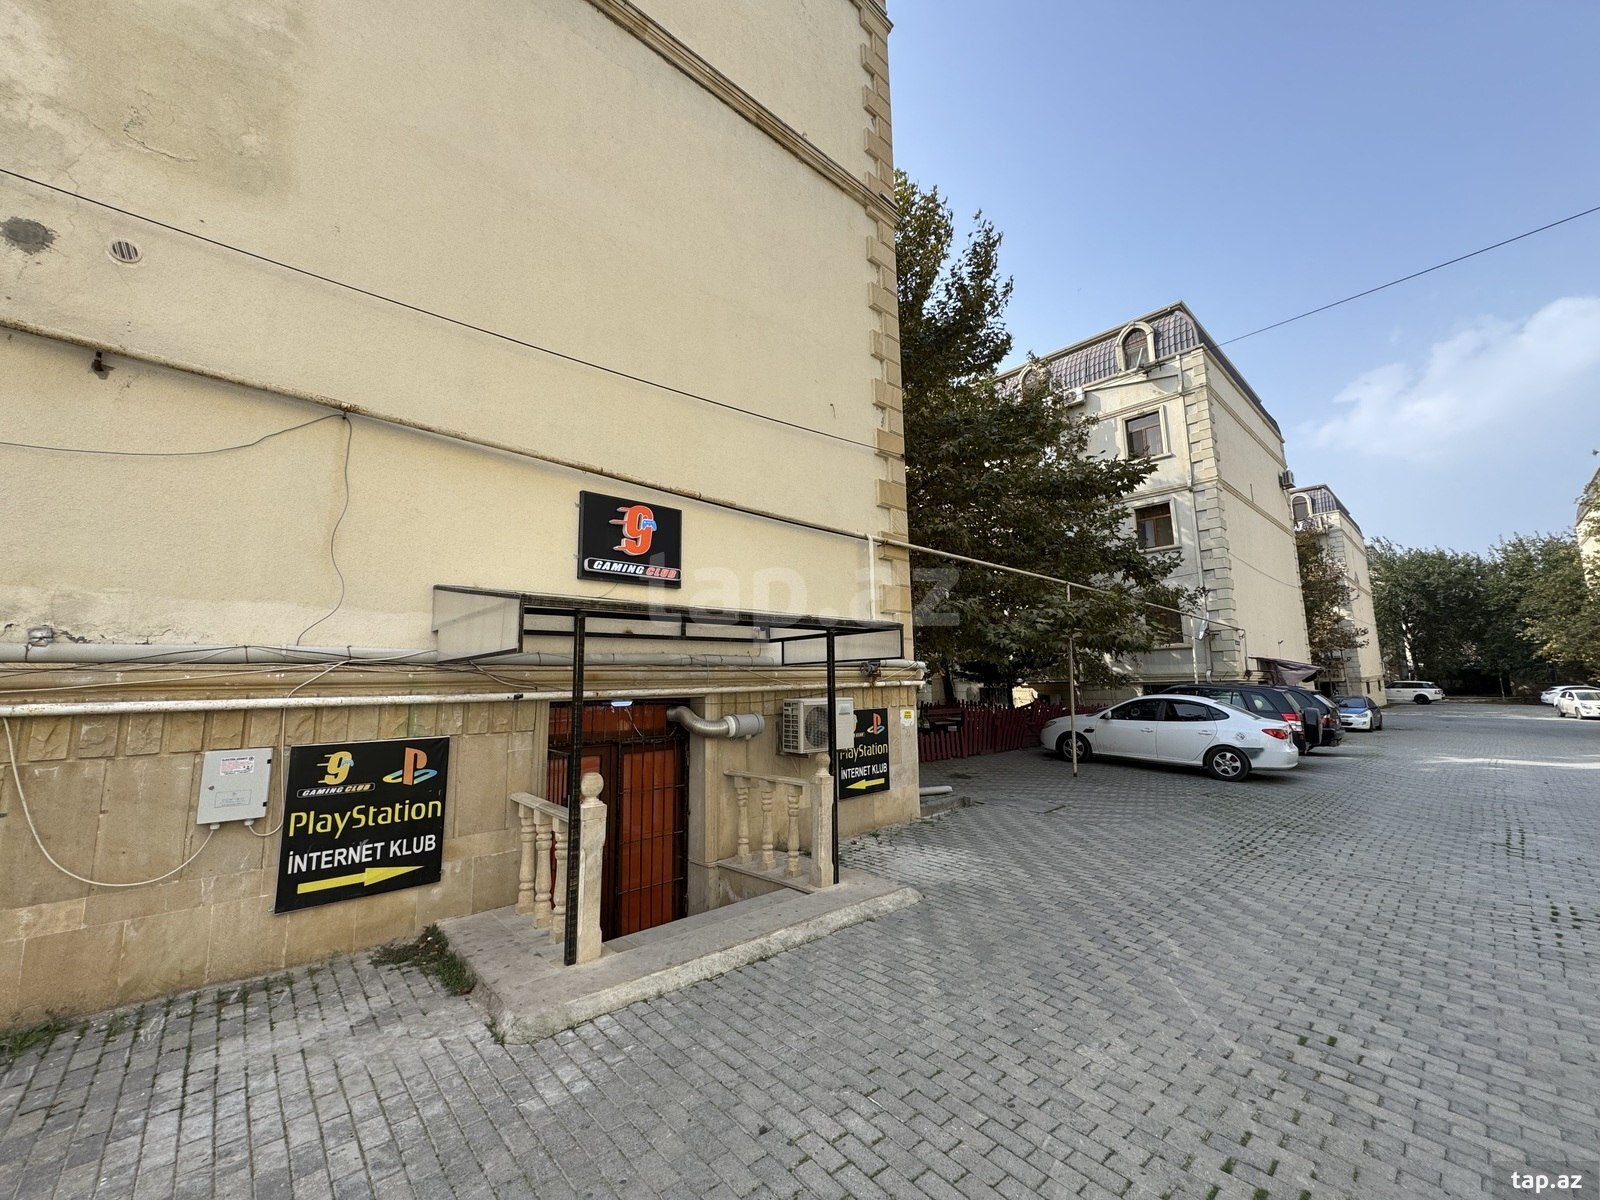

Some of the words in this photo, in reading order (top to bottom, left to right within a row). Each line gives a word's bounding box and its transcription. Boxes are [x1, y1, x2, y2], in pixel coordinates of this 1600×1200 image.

[593, 560, 645, 575] GAMING
[645, 566, 677, 579] CLUB
[840, 766, 871, 780] İNTERNET
[871, 762, 887, 775] KLUB
[302, 787, 344, 797] GAMING
[344, 783, 372, 793] CLUB
[288, 800, 442, 840] PlayStation
[287, 841, 385, 875] İNTERNET
[389, 834, 437, 858] KLUB
